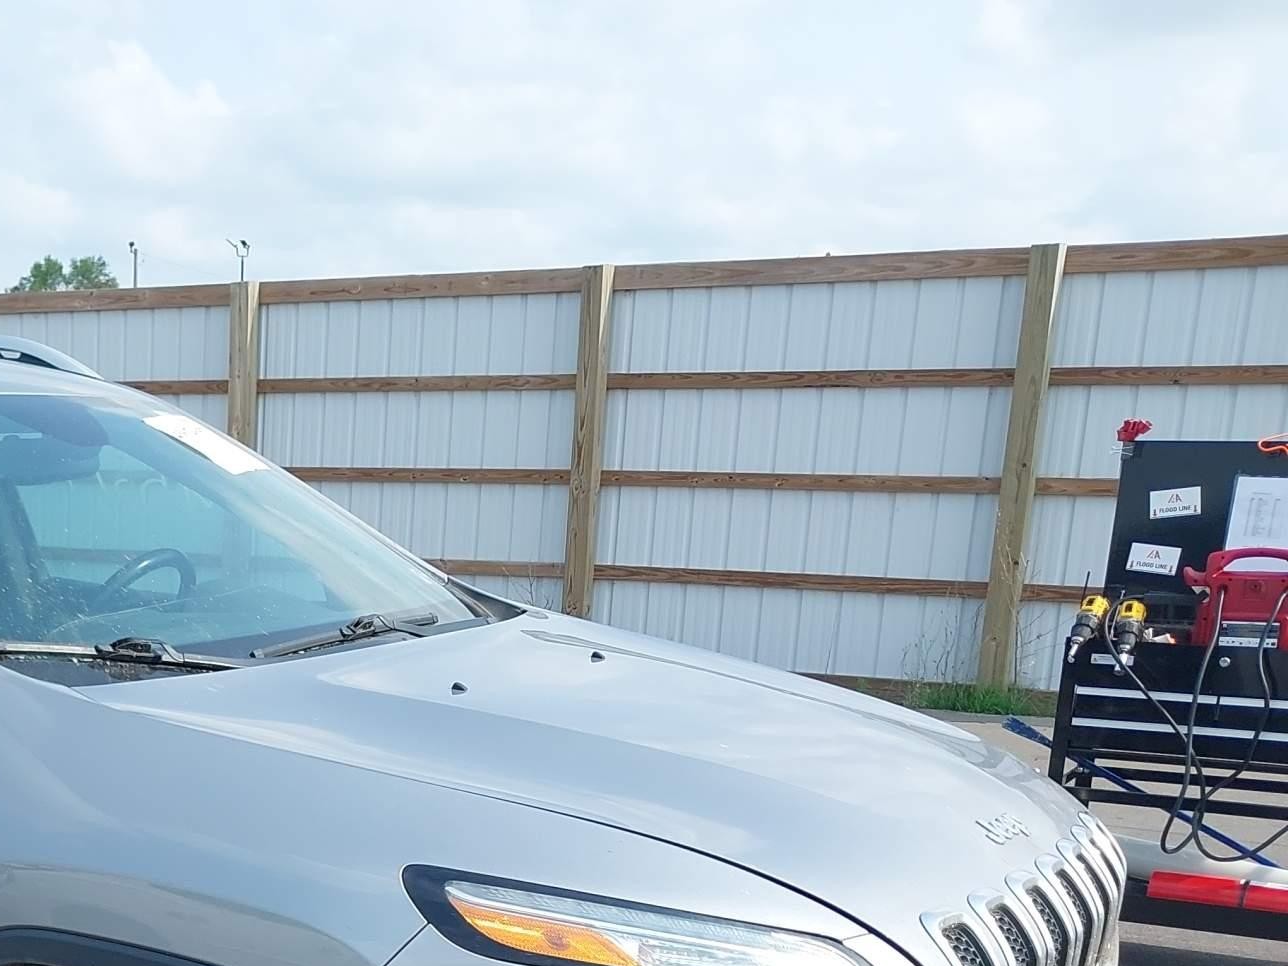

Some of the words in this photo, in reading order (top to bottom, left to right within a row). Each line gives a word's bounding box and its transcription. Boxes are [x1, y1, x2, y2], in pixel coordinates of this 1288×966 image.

[1159, 506, 1178, 514] FLOOD
[1178, 504, 1192, 512] LINE
[1135, 560, 1154, 568] FLOOD
[1155, 562, 1168, 570] LINE
